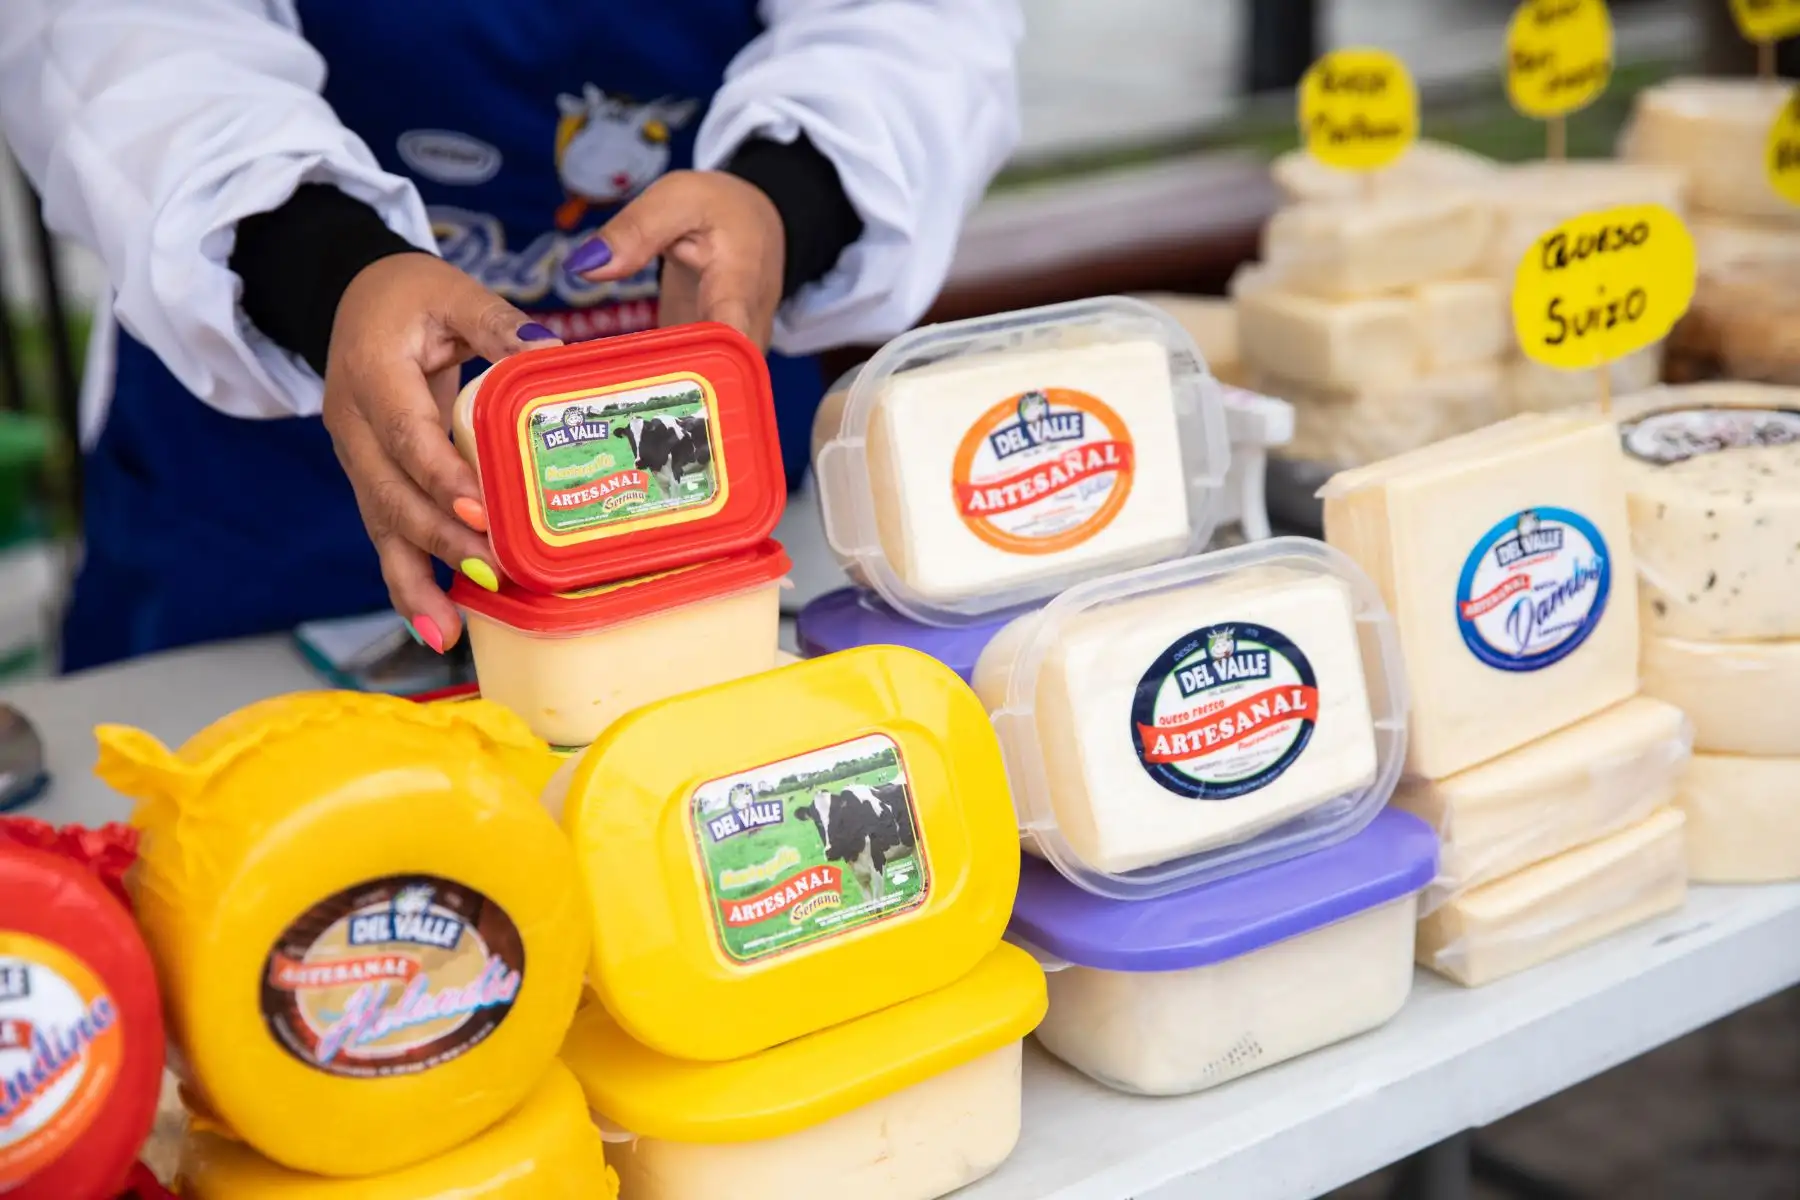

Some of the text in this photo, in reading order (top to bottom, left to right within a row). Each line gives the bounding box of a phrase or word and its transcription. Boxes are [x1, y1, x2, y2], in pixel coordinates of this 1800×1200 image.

[546, 424, 606, 447] DEL VALLE
[995, 424, 1029, 455] DEL
[1026, 414, 1081, 441] VALLE
[551, 473, 641, 507] ARTESANAL
[969, 445, 1119, 509] ARTESANAL
[604, 491, 645, 511] Serrana
[1499, 538, 1523, 563] DEL
[1521, 531, 1560, 552] VALLE
[1180, 665, 1214, 693] DEL
[1214, 653, 1267, 682] VALLE
[1152, 690, 1308, 755] ARTESANAL
[1159, 700, 1225, 726] QUESO FRESCO
[711, 803, 781, 840] DEL VALLE
[728, 869, 834, 923] ARTESANAL
[793, 892, 839, 921] Serrana
[352, 913, 460, 949] DEL VALLE
[281, 957, 409, 985] ARTESANAL
